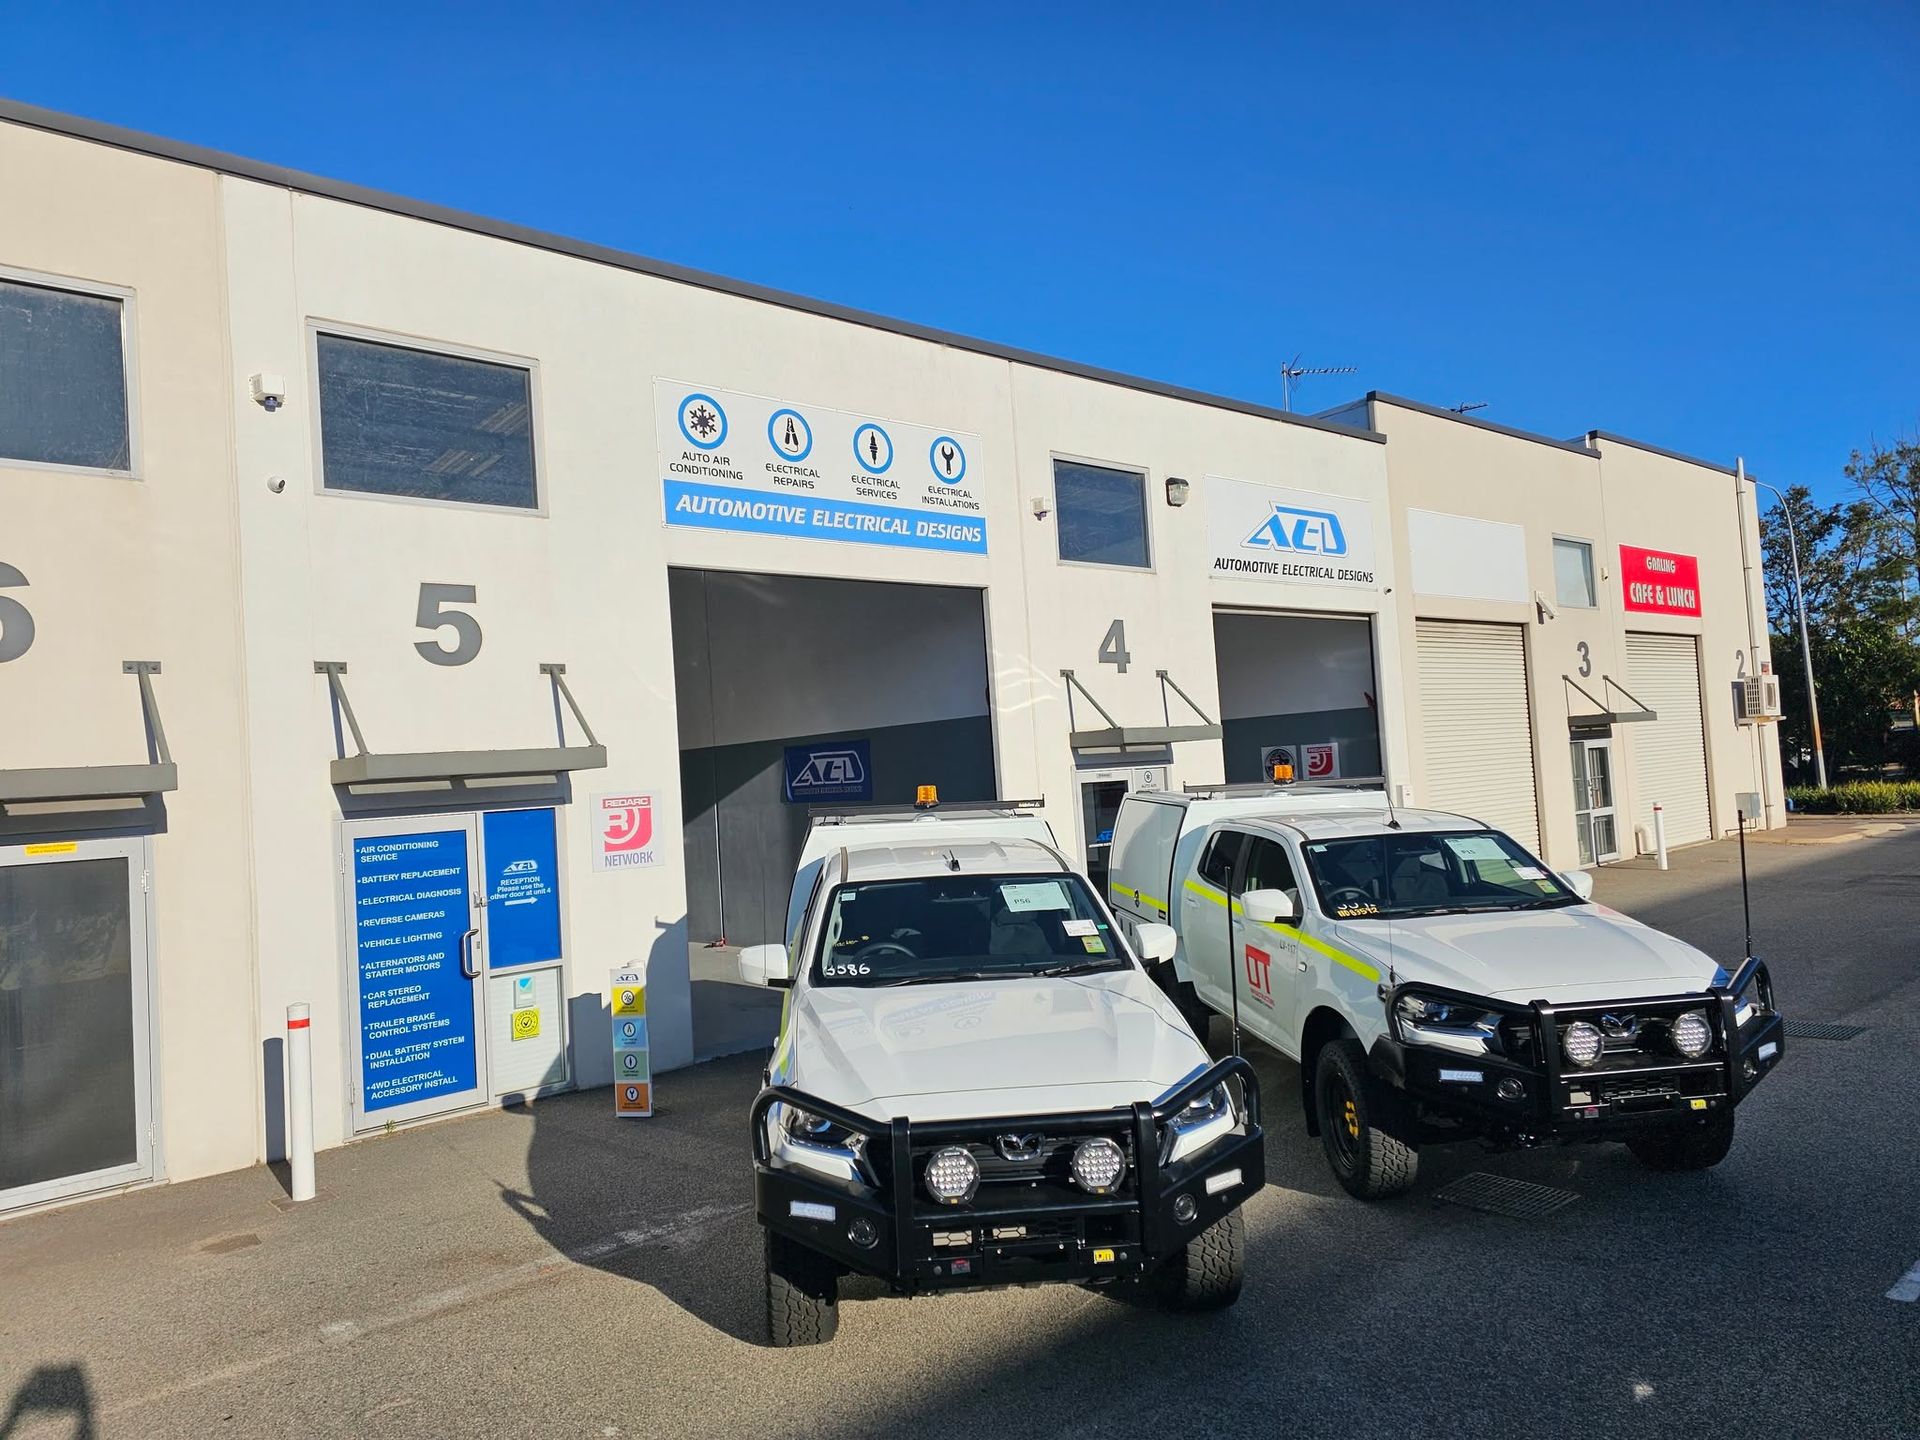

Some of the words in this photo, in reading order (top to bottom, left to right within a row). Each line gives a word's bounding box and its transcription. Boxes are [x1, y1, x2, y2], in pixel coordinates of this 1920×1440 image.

[682, 452, 710, 464] AUTO
[712, 454, 731, 466] AIR
[669, 462, 744, 481] CONDITIONING
[765, 463, 820, 478] ELECTRICAL
[773, 477, 816, 490] REPAIRS
[851, 474, 900, 490] ELECTRICAL
[856, 486, 898, 500] SERVICES
[928, 485, 973, 500] ELECTRICAL
[921, 496, 980, 510] INSTALLATIONS
[675, 494, 806, 525] AUTOMOTIVE
[812, 510, 911, 536] ELECTRICAL
[915, 520, 982, 542] DESIGNS
[1214, 557, 1279, 575] AUTOMOTIVE
[1282, 564, 1335, 580] ELECTRICAL
[1338, 569, 1374, 583] DESIGNS
[1630, 582, 1654, 604] CAFE
[1656, 586, 1664, 606] &
[1666, 586, 1696, 608] LUNCH
[414, 582, 482, 666] 5
[1098, 620, 1131, 674] 4
[1577, 641, 1592, 678] 3
[1736, 650, 1746, 680] 2
[605, 798, 648, 808] REDARC
[360, 844, 376, 854] AIR
[377, 840, 439, 852] CONDITIONING
[360, 853, 398, 863] SERVICE
[604, 851, 654, 868] NETWORK
[362, 874, 400, 884] BATTERY
[401, 868, 460, 880] REPLACEMENT
[500, 876, 540, 886] RECEPTION
[362, 894, 416, 906] ELECTRICAL
[417, 888, 462, 900] DIAGNOSIS
[364, 916, 403, 928] REVERSE
[404, 910, 445, 922] CAMERAS
[364, 937, 402, 949] VEHICLE
[403, 932, 442, 944] LIGHTING
[365, 955, 426, 970] ALTERNATORS
[427, 952, 444, 961] AND
[366, 968, 404, 980] STARTER
[405, 962, 440, 974] MOTORS
[368, 990, 386, 1000] CAR
[388, 985, 422, 997] STEREO
[368, 992, 430, 1010] REPLACEMENT
[369, 1018, 405, 1030] TRAILER
[406, 1012, 436, 1024] BRAKE
[369, 1026, 411, 1040] CONTROL
[412, 1018, 450, 1032] SYSTEMS
[370, 1049, 394, 1060] DUAL
[394, 1042, 432, 1056] BATTERY
[433, 1036, 465, 1048] SYSTEM
[370, 1052, 430, 1070] INSTALLATION
[370, 1080, 390, 1091] 4WD
[392, 1070, 444, 1087] ELECTRICAL
[371, 1084, 423, 1100] ACCESSORY
[424, 1076, 458, 1090] INSTALL
